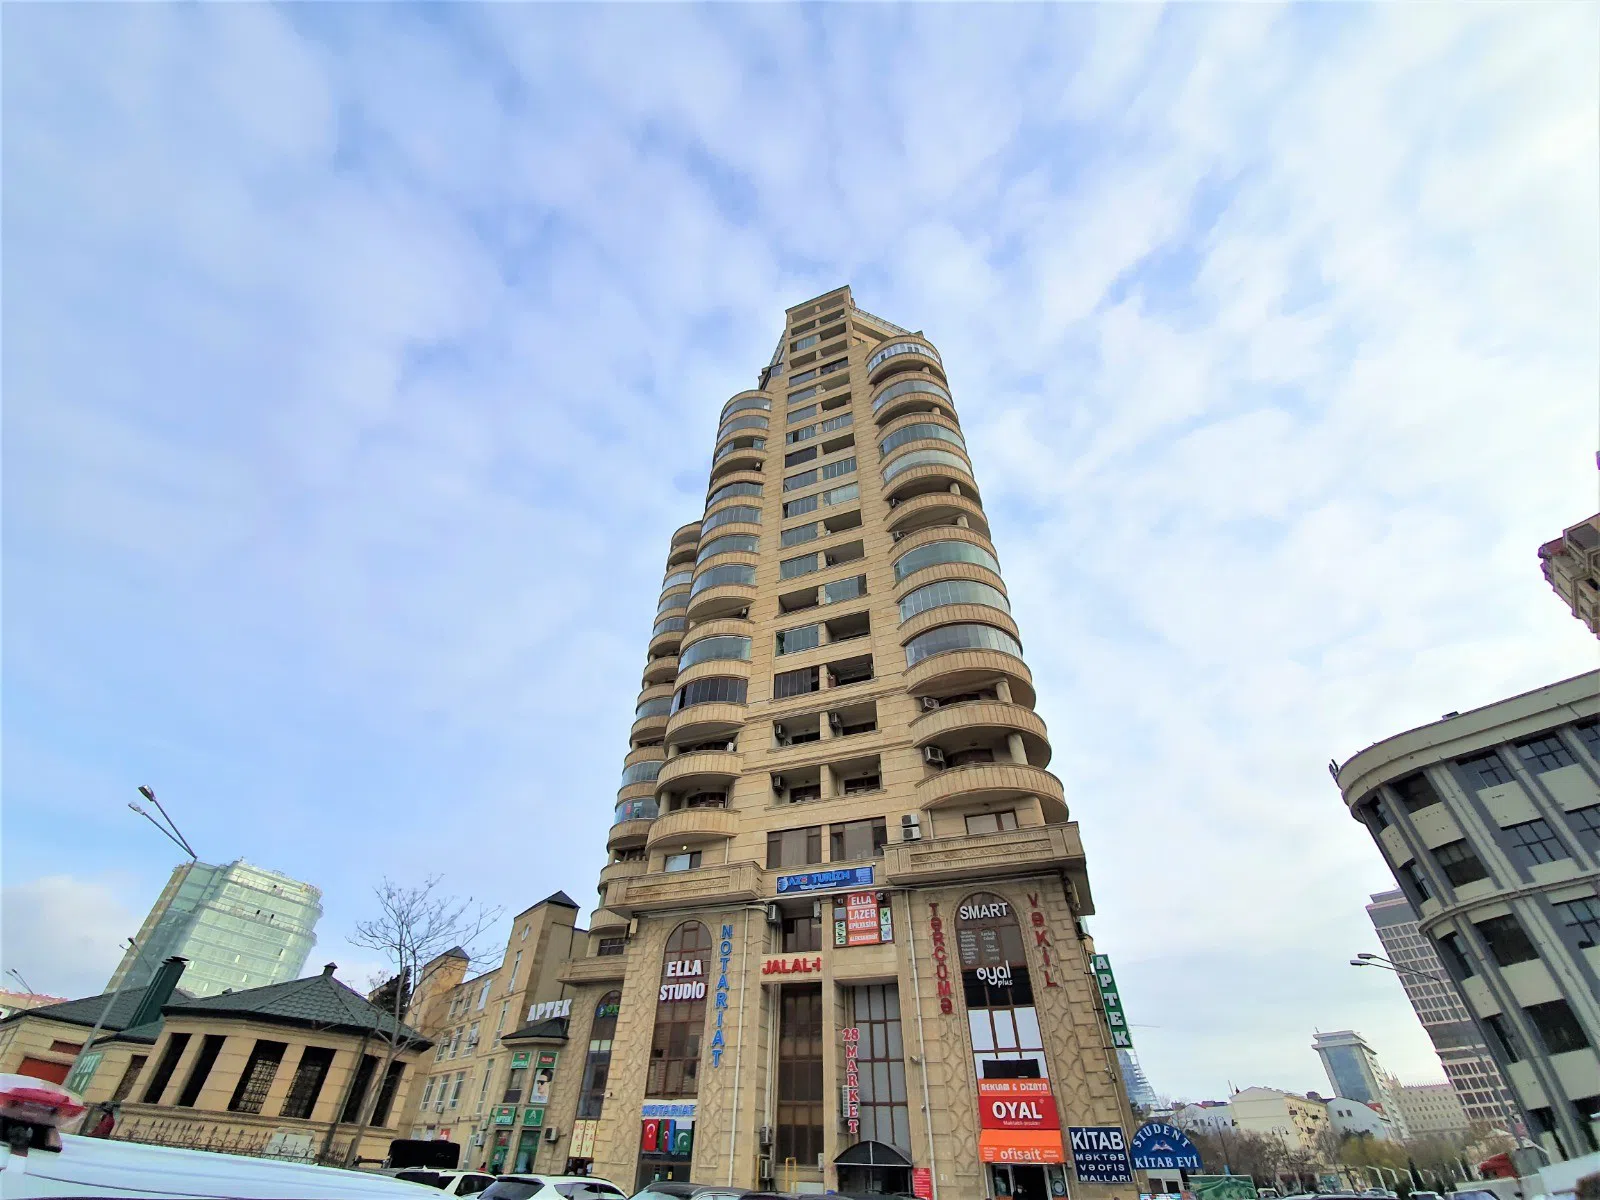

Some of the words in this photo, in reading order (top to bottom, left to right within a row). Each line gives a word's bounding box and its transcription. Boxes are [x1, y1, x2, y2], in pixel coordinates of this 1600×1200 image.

[851, 896, 872, 906] ELLA
[848, 909, 877, 920] LAZER
[960, 902, 1008, 920] SMART
[667, 959, 702, 977] ELLA
[976, 960, 1011, 985] oyal
[659, 980, 706, 1001] STUDİO
[997, 978, 1013, 989] plus
[1096, 956, 1130, 1046] APTEK
[527, 999, 572, 1022] APTEK
[842, 1027, 859, 1042] 28
[845, 1044, 859, 1134] MARKET
[992, 1101, 1043, 1119] OYAL
[1070, 1128, 1125, 1151] KİTAB
[1132, 1123, 1191, 1148] STUDENT
[1000, 1147, 1042, 1161] ofisait
[1075, 1153, 1126, 1161] MƏKTƏB
[1135, 1155, 1174, 1169] KİTAB
[1176, 1152, 1199, 1168] EVİ
[1080, 1163, 1096, 1172] VƏ
[1098, 1162, 1125, 1172] OFİS
[1080, 1173, 1131, 1182] MALLARI
